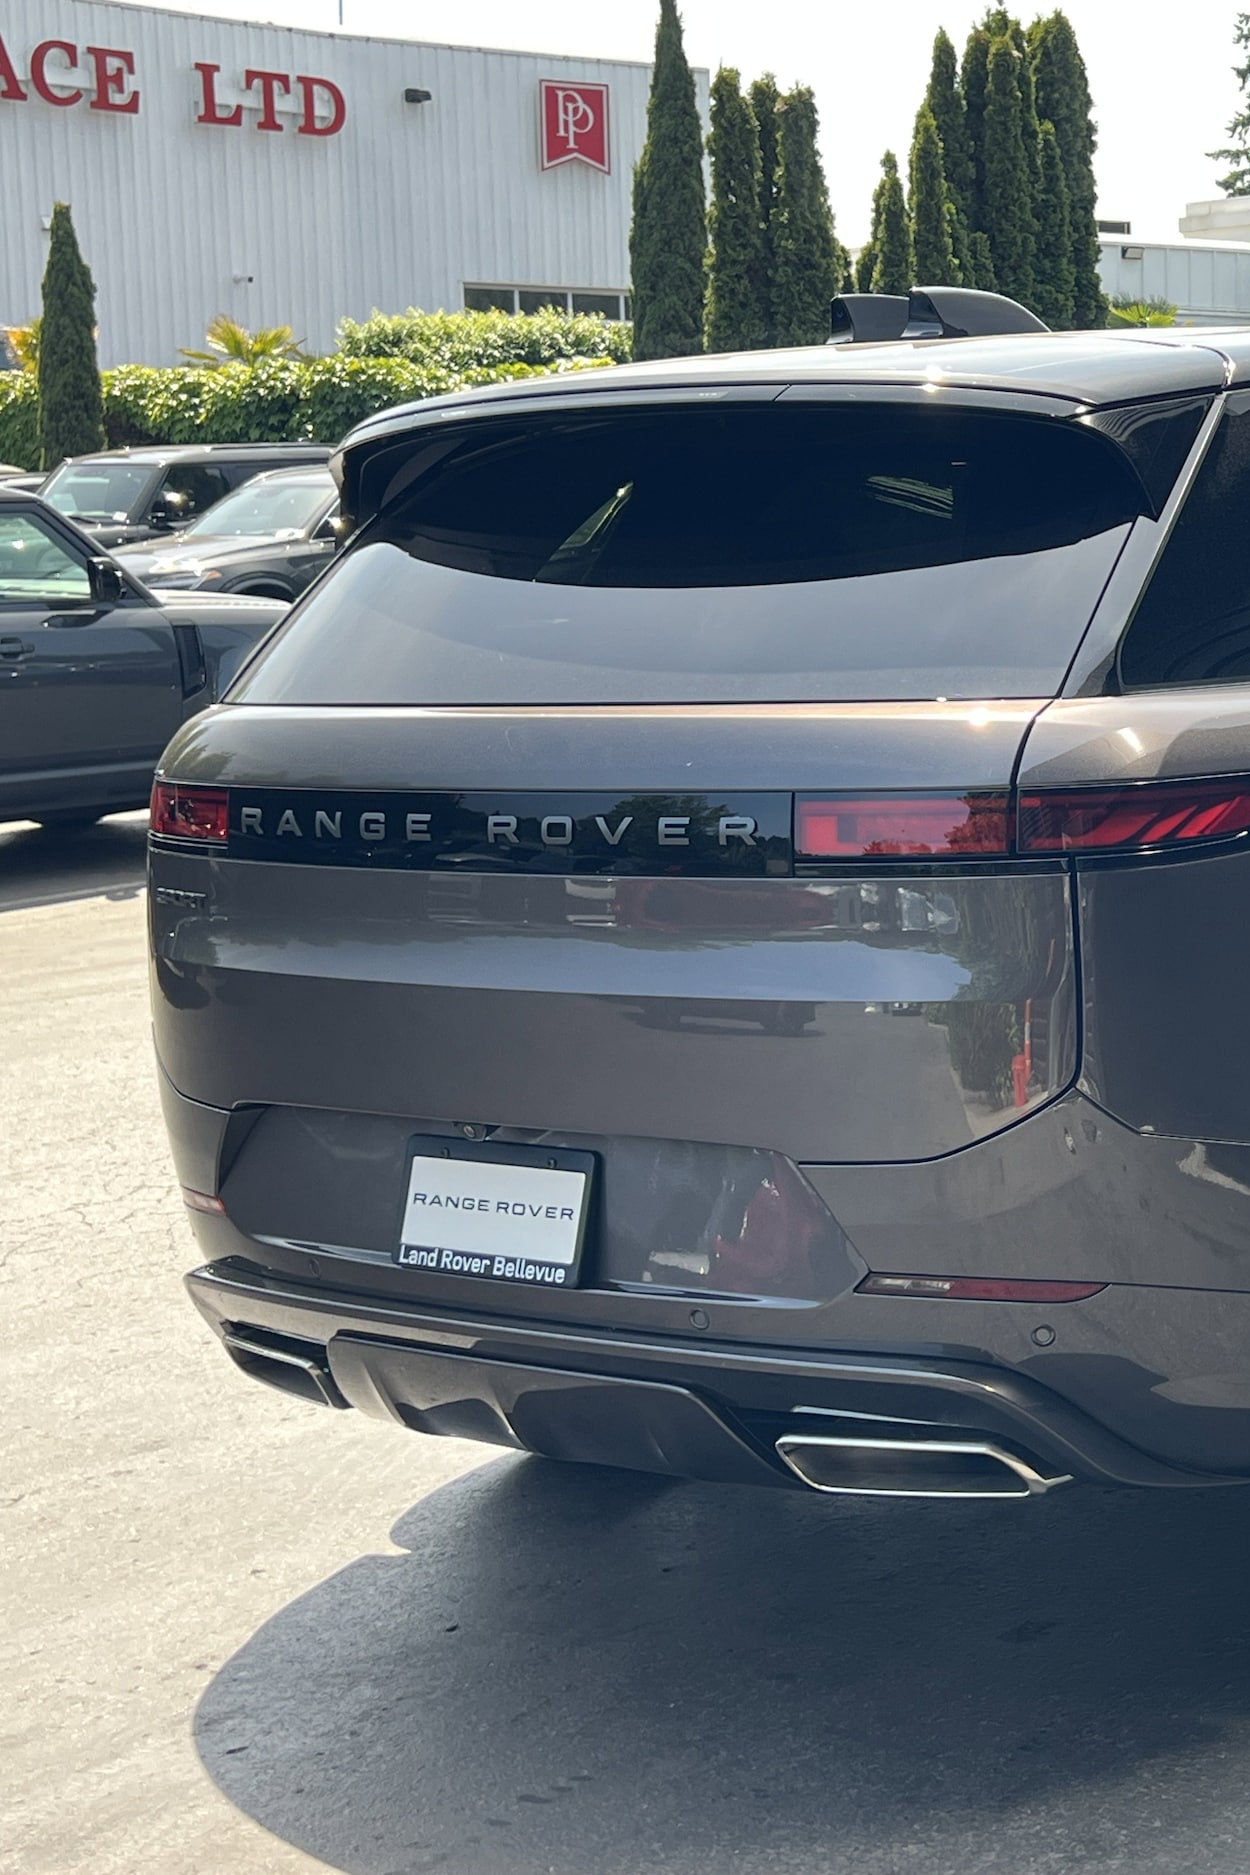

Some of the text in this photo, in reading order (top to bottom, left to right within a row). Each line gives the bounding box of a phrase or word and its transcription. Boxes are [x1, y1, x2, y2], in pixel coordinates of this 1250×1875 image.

[194, 62, 346, 137] LTD
[240, 806, 757, 846] RANGE ROVER
[413, 1193, 574, 1220] RANGE ROVER
[399, 1244, 566, 1284] Land Rover Bellevue
